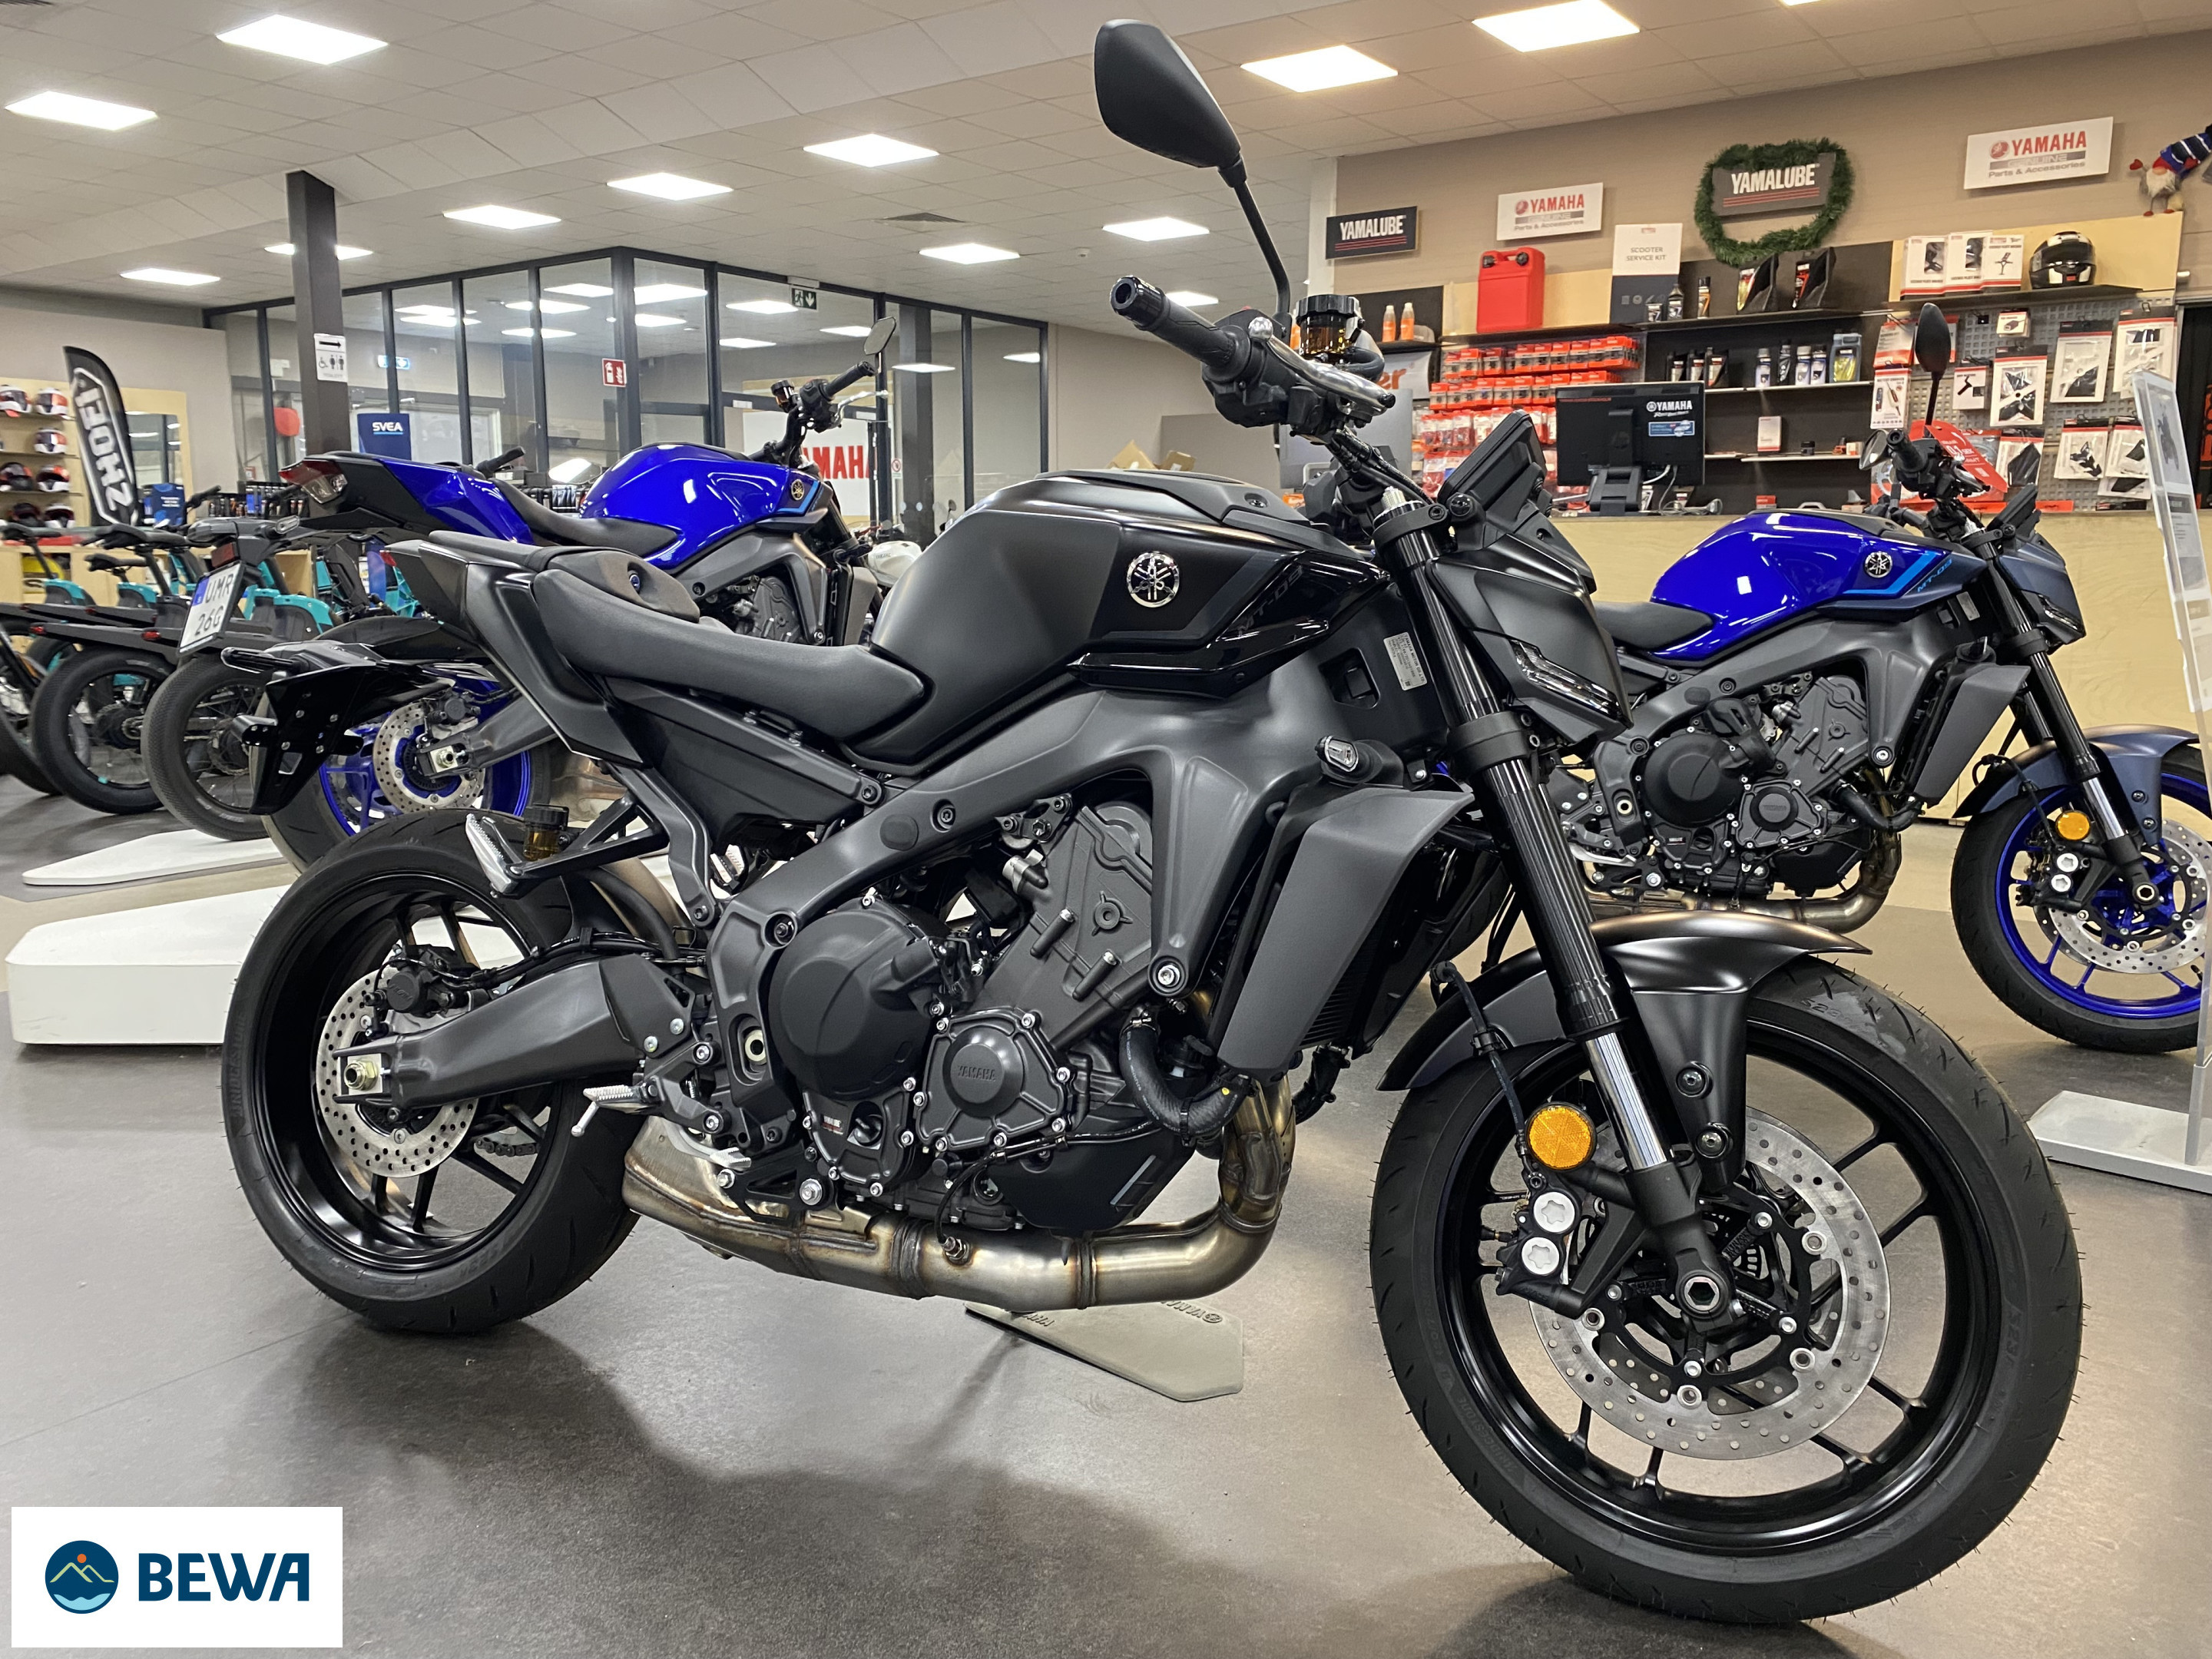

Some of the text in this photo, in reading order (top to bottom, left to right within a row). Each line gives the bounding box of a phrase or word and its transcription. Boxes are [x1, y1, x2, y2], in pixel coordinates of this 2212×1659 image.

[2012, 131, 2087, 156] YAMAHA
[2008, 153, 2068, 167] GENUINE
[1988, 169, 2013, 178] Parts
[2025, 161, 2085, 174] Accessories
[1731, 164, 1816, 194] YAMALUBE
[1531, 194, 1584, 214] YAMAHA
[1339, 215, 1404, 240] YAMALUBE
[1656, 400, 1693, 412] YAMAHA
[373, 422, 403, 432] SVEA
[194, 605, 224, 636] 26G
[958, 1065, 997, 1082] YAMAHA
